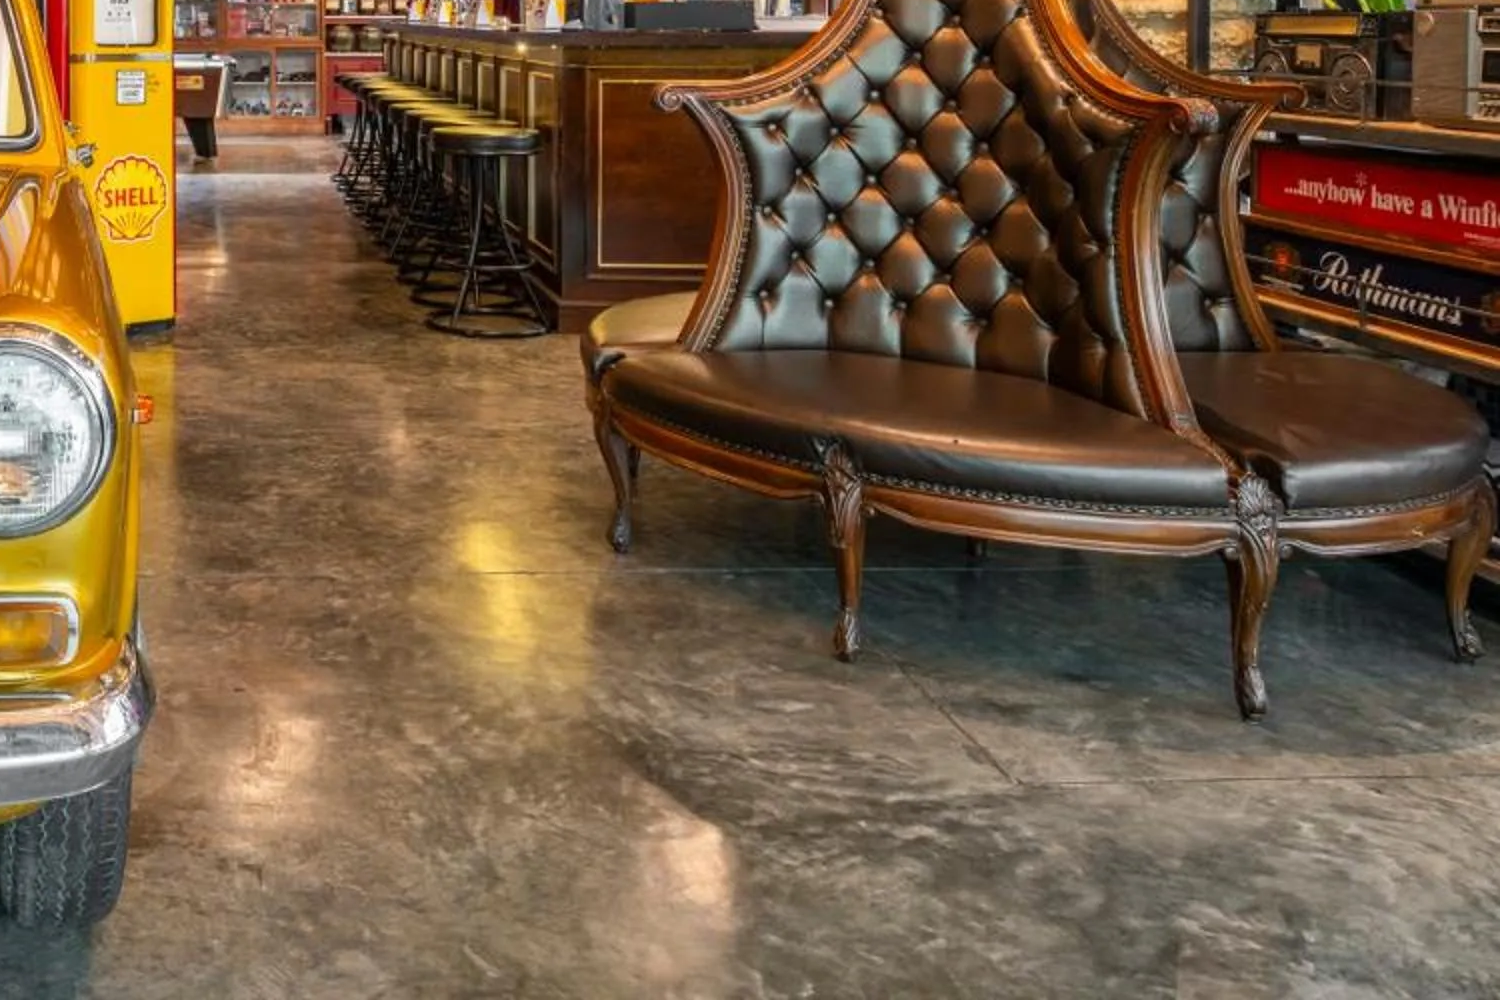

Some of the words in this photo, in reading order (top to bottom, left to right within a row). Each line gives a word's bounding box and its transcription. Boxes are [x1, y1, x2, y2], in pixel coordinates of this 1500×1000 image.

[103, 186, 158, 209] SHELL
[1370, 184, 1415, 215] have
[1420, 198, 1434, 220] a
[1437, 193, 1500, 229] Winfi
